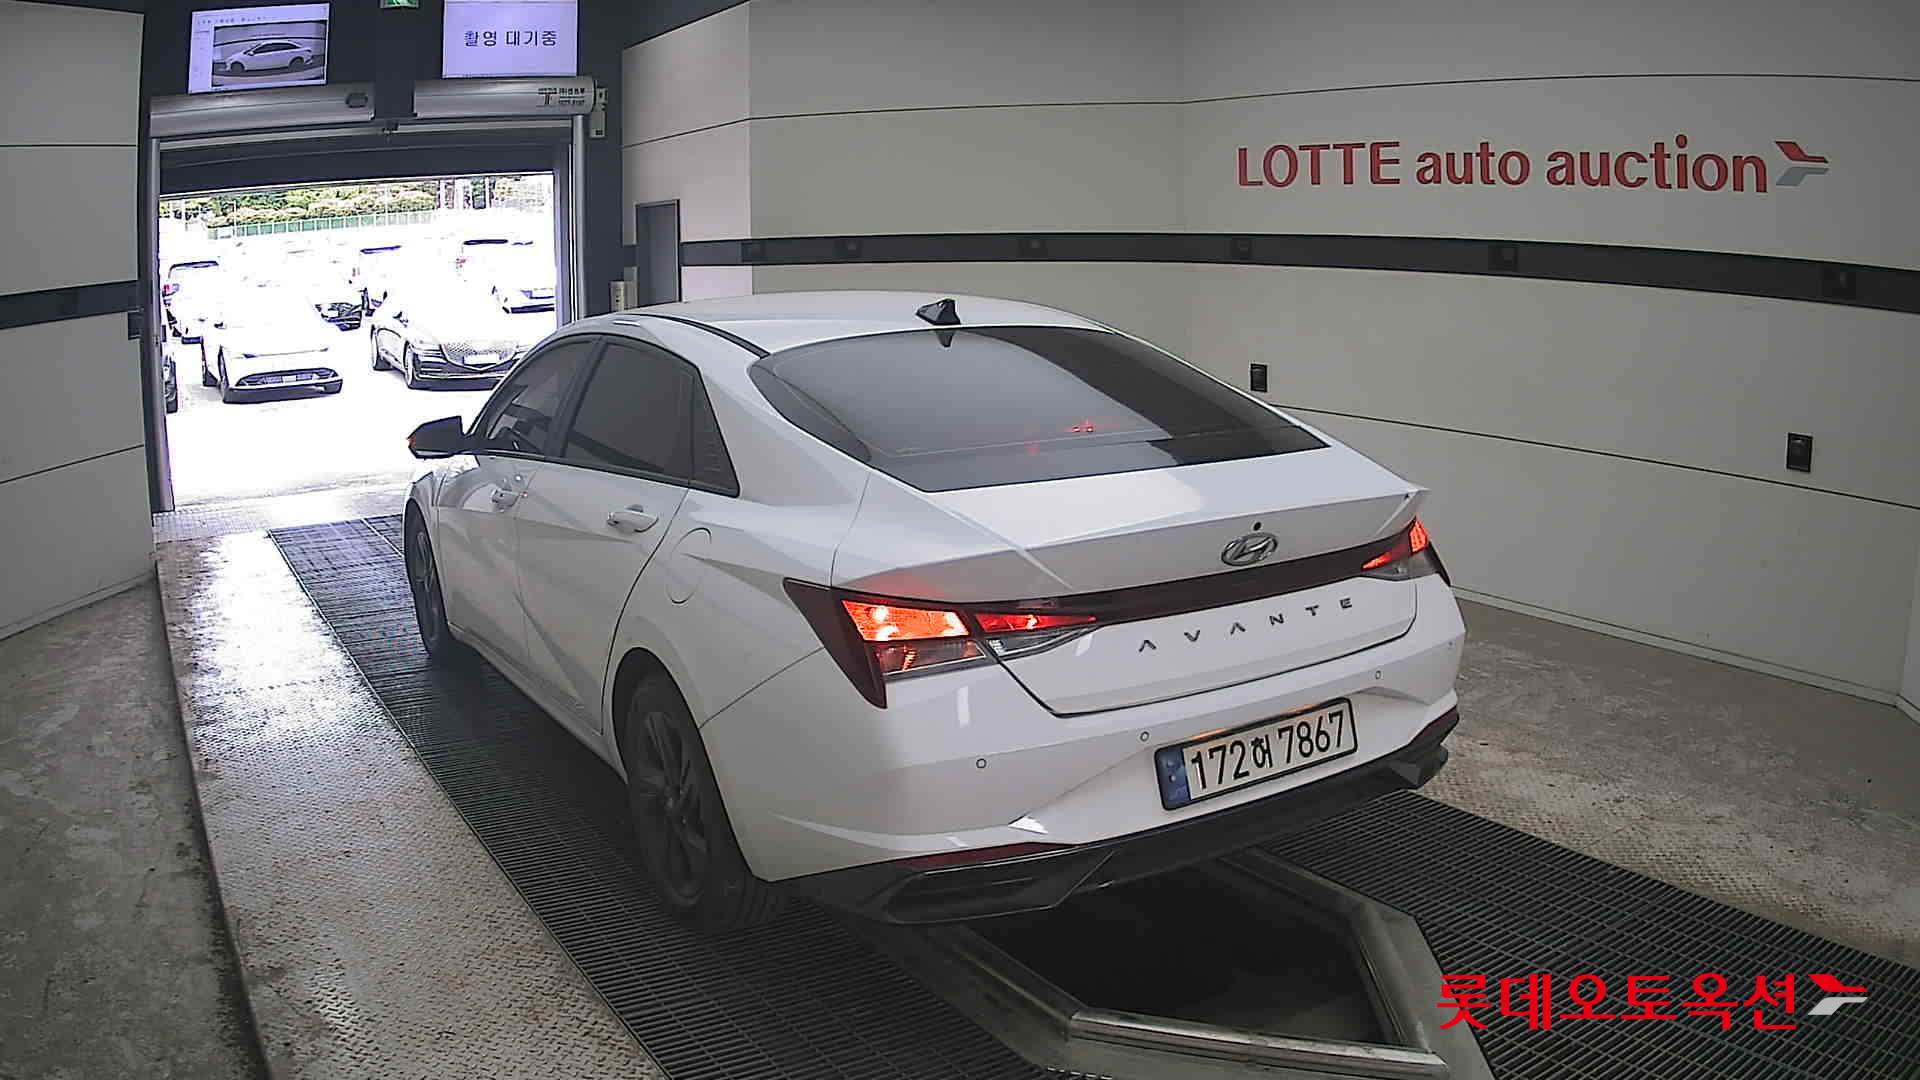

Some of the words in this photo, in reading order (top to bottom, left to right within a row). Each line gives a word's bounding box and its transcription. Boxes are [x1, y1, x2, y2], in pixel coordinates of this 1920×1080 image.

[464, 30, 497, 47] 촬영
[505, 29, 557, 47] 대기중
[1237, 141, 1400, 188] LOTTE
[1416, 142, 1531, 186] auto
[1546, 134, 1768, 193] auction
[1138, 597, 1353, 653] AVANTE
